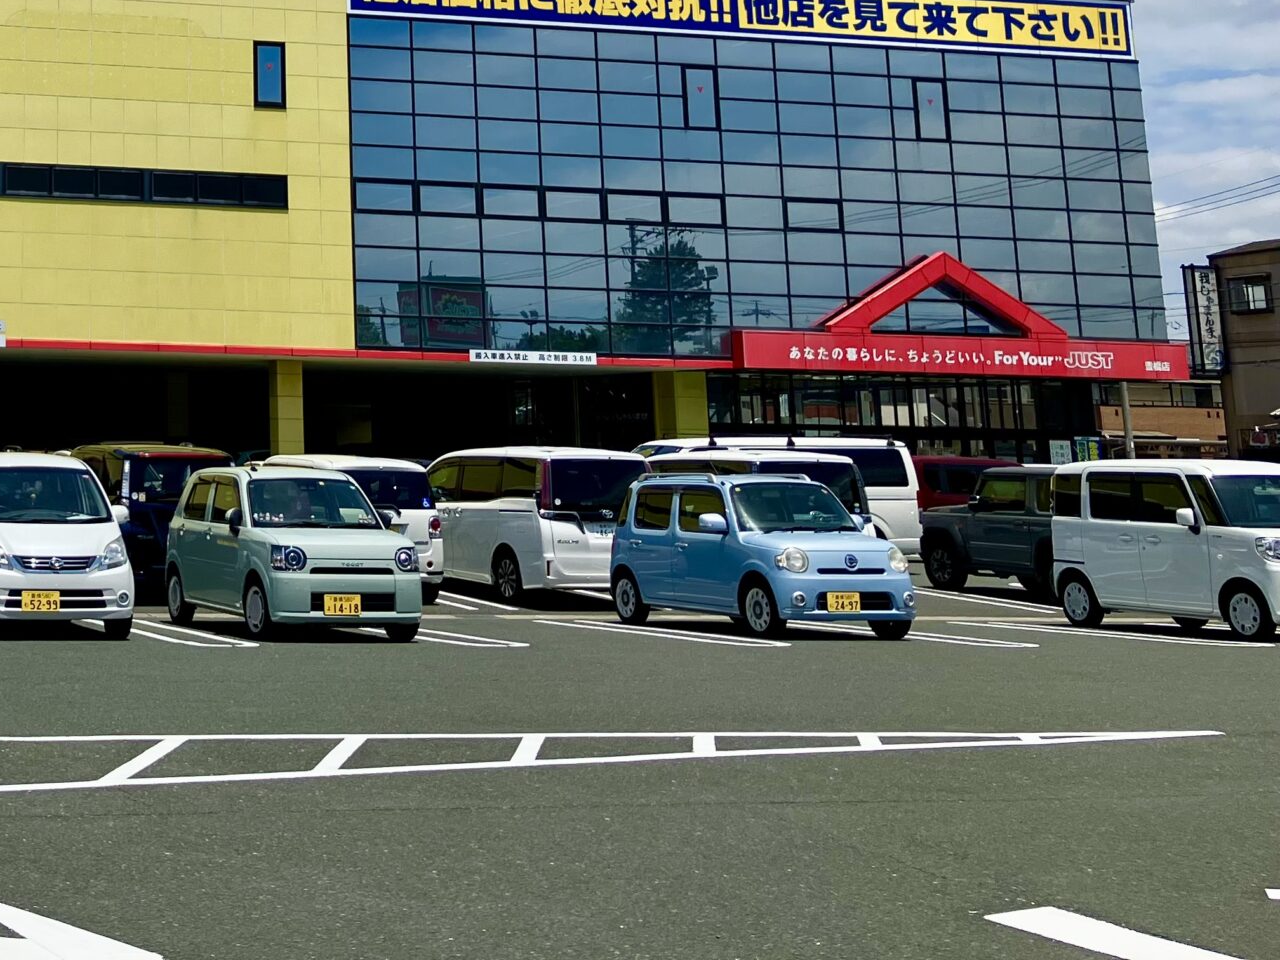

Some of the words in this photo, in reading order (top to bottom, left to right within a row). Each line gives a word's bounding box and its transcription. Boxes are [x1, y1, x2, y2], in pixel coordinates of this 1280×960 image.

[538, 353, 568, 363] 高さ制限
[1064, 352, 1114, 370] JUST
[30, 600, 58, 610] 52-99
[333, 603, 359, 613] 14-18
